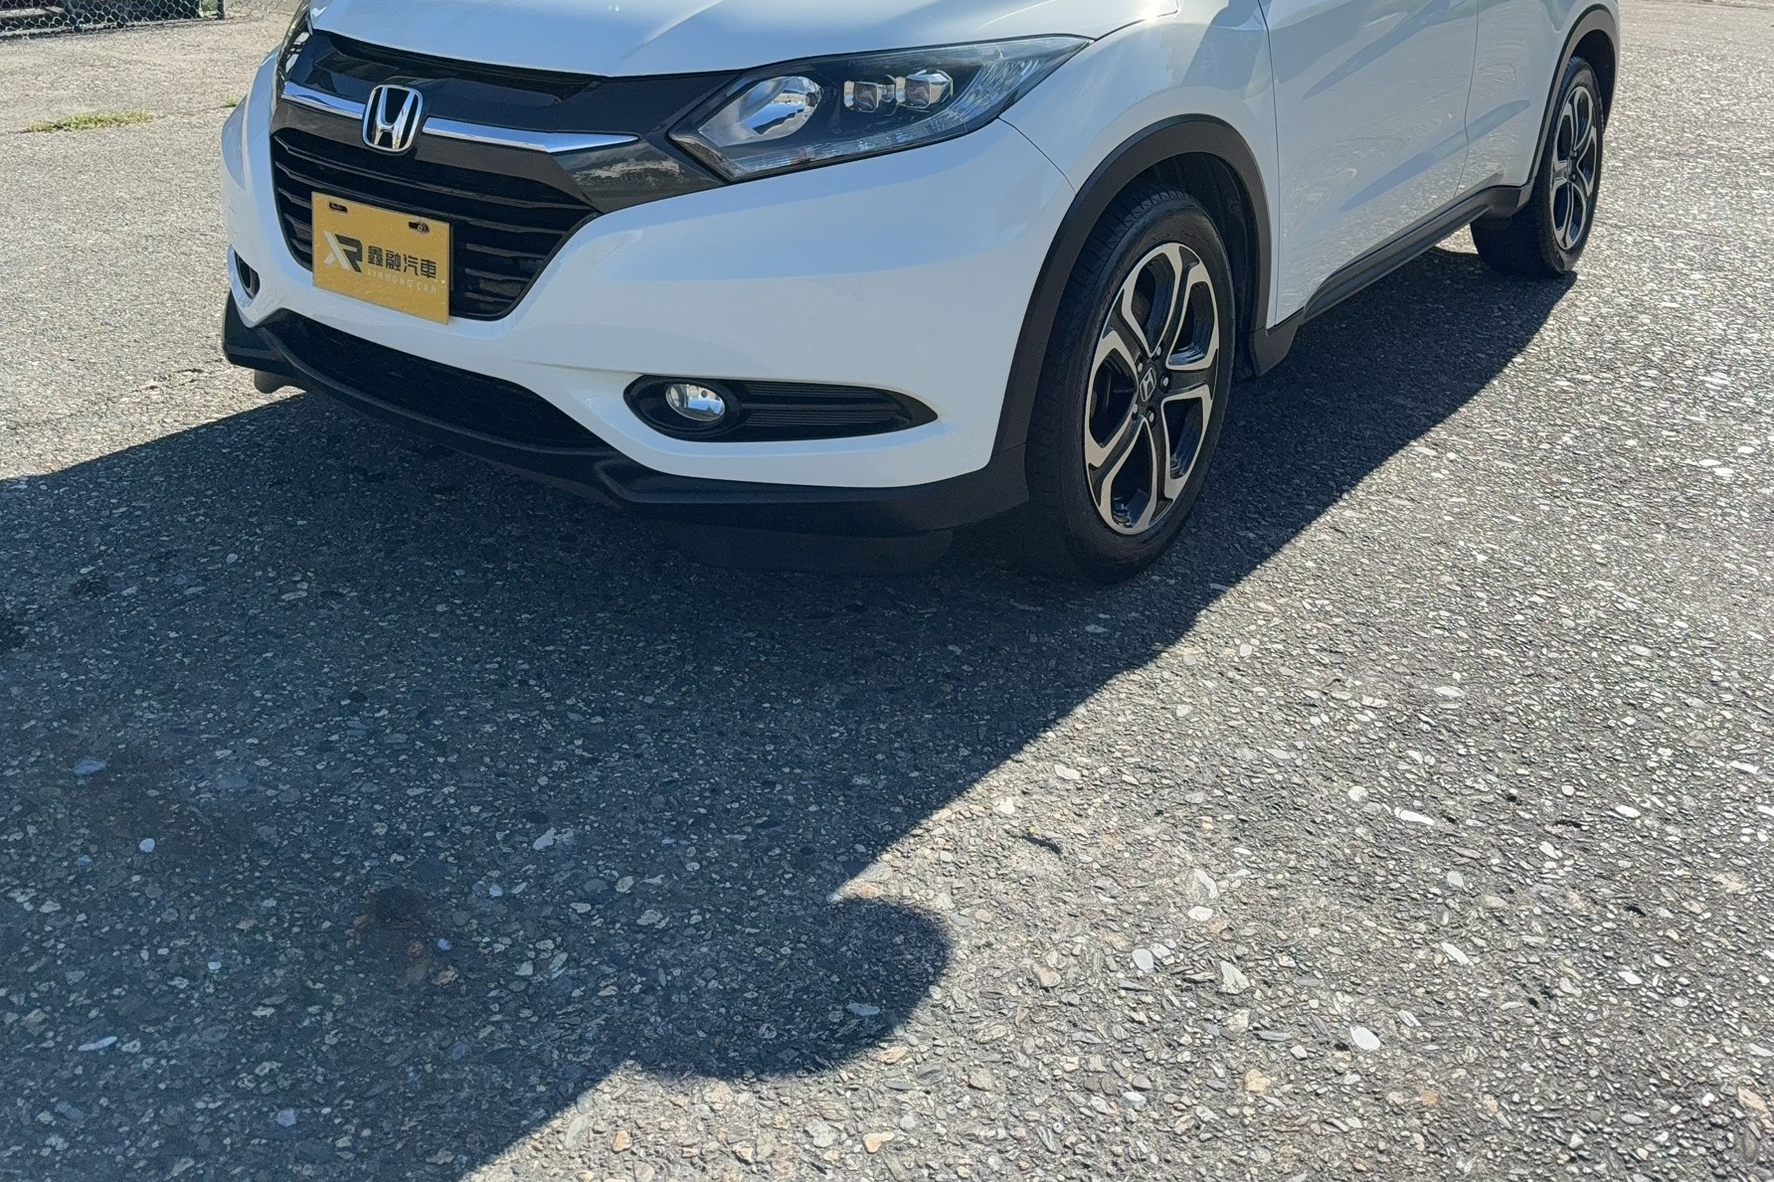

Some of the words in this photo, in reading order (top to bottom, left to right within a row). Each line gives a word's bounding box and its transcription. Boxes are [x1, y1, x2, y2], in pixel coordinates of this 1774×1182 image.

[367, 245, 437, 279] 鑫融汽車
[417, 281, 438, 294] CAR
